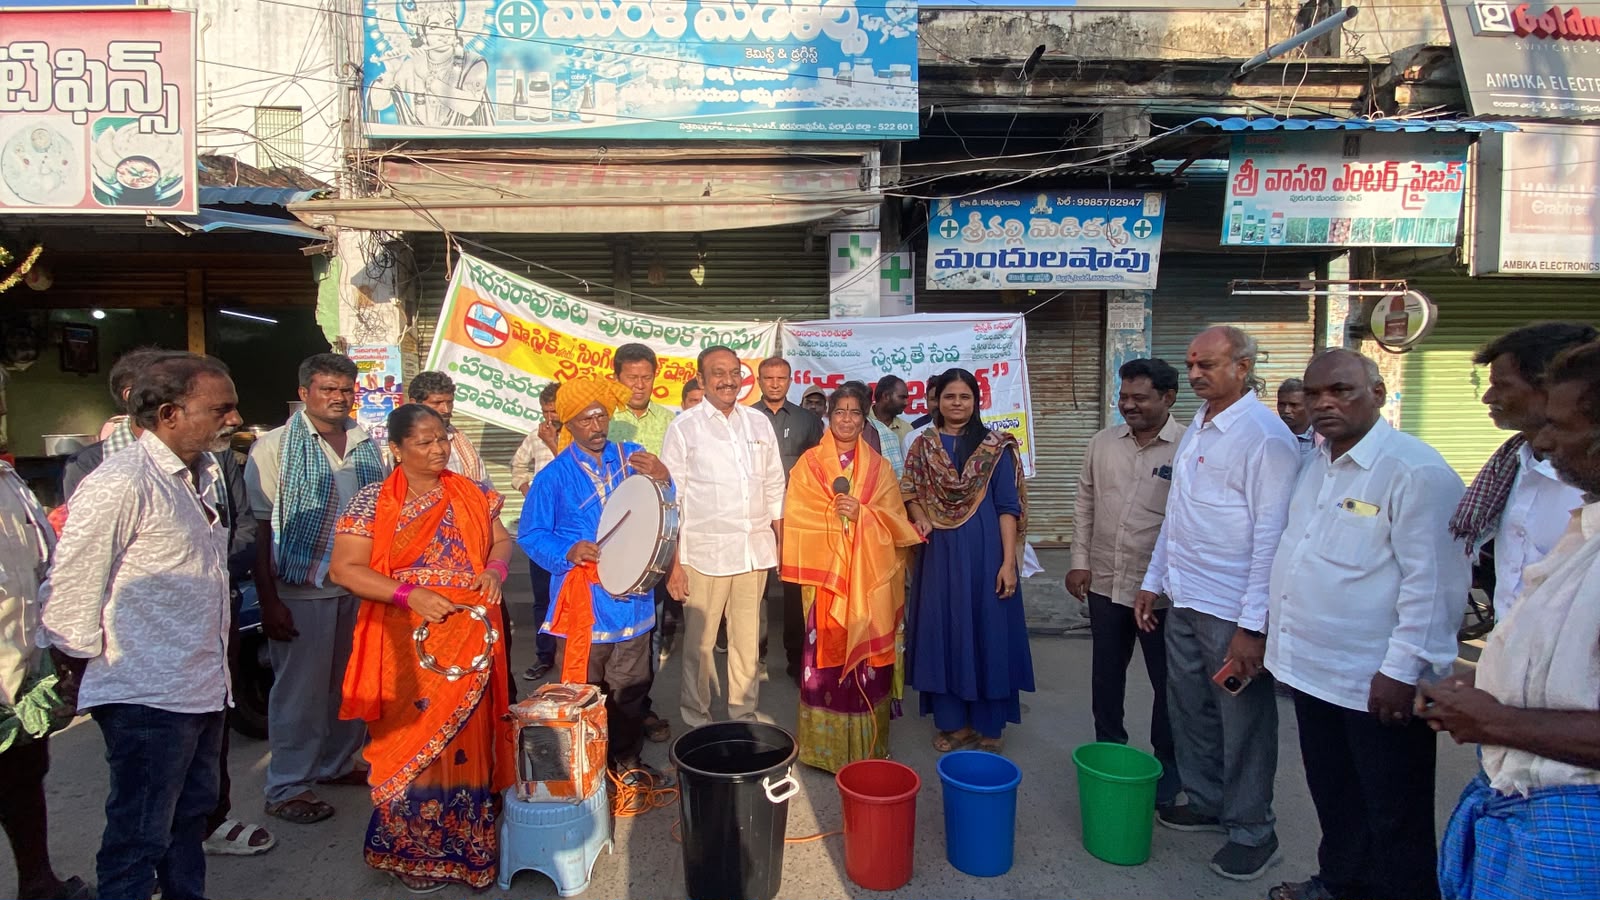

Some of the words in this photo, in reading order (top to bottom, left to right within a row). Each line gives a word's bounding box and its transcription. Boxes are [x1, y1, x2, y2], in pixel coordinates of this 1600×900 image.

[777, 48, 787, 59] &
[1486, 73, 1547, 90] AMBIKA
[878, 123, 896, 131] 522
[897, 123, 914, 131] 601
[1232, 159, 1259, 196] శ్రీ
[1264, 163, 1327, 193] వాసవి
[1332, 161, 1400, 193] ఎంటర్
[1077, 198, 1142, 206] 9985762947
[1503, 260, 1537, 270] AMBIKA
[1539, 261, 1600, 271] ELECTRONICS
[470, 264, 589, 326] నరసరావుపేట
[598, 311, 700, 348] పురపాలక
[577, 342, 616, 370] సింగి
[928, 342, 961, 364] సేవ
[458, 355, 547, 399] పర్యావర
[663, 361, 697, 385] ప్లాస్టి
